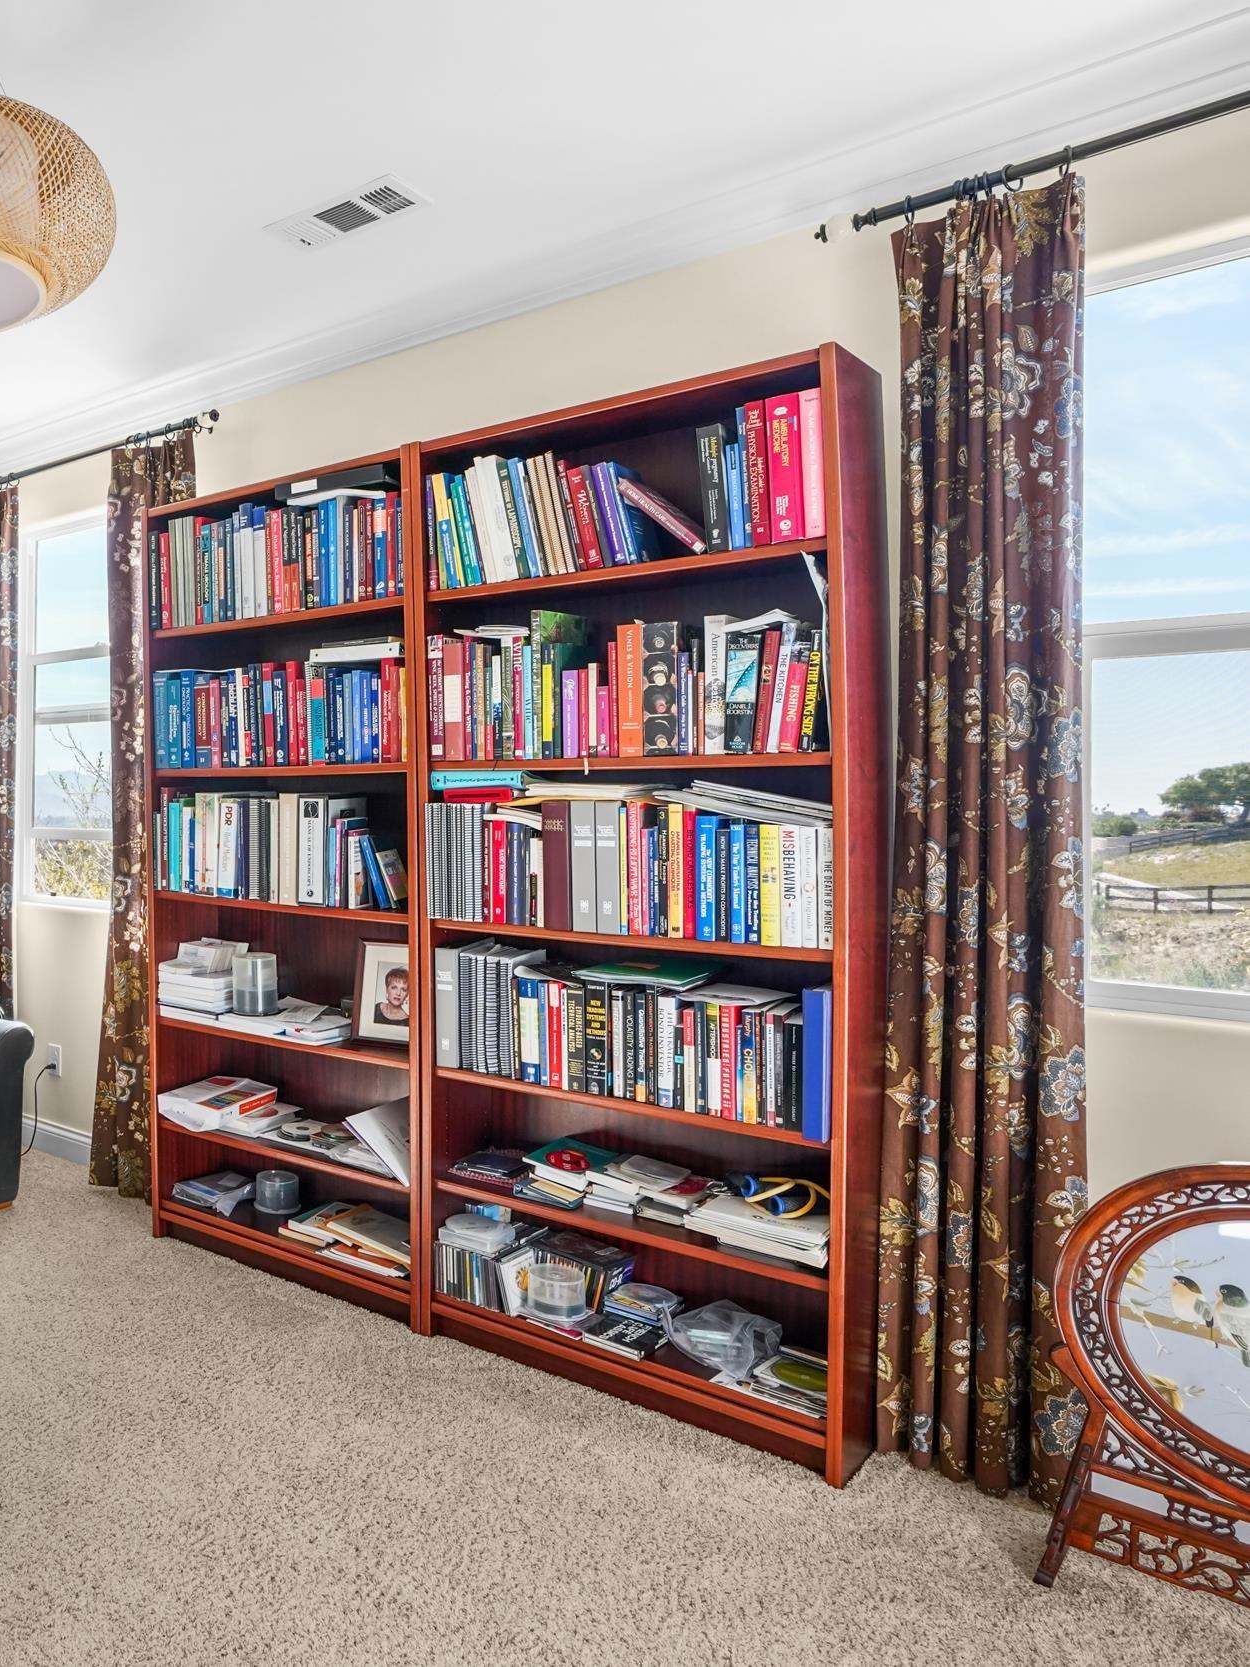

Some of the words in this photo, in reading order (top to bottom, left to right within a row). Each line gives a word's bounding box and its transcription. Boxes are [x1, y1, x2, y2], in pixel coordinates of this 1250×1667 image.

[709, 436, 718, 458] Multiple
[748, 430, 757, 466] PHYSICAL
[772, 419, 781, 454] MEDICINE
[780, 418, 790, 467] AMBULATORY
[749, 467, 761, 523] EXAMINATION
[507, 508, 521, 549] LAPAROSCOPY
[513, 641, 522, 671] wine
[711, 632, 721, 676] American
[780, 653, 788, 668] THE
[810, 651, 821, 664] ON
[775, 670, 786, 704] KITCHEN
[809, 666, 819, 683] THE
[786, 684, 800, 721] FISHING
[804, 683, 818, 715] WRONG
[801, 716, 815, 736] SIDE
[225, 806, 233, 826] PDR
[629, 806, 638, 847] MASTERING
[630, 847, 638, 877] ELLIOTT
[720, 850, 726, 858] TO
[747, 839, 758, 864] TECHNICAL
[747, 865, 758, 890] ANALYSIS
[783, 830, 796, 900] MISBEHAVING
[824, 860, 832, 873] THE
[824, 875, 832, 897] DEATH
[824, 899, 832, 907] OF
[824, 910, 832, 934] MONEY
[590, 999, 601, 1007] NEW
[722, 1013, 730, 1063] INDUSTRIES
[744, 1015, 752, 1037] Murphy
[568, 1028, 576, 1053] ANALYSIS
[722, 1067, 730, 1099] FUTURE
[621, 1324, 653, 1343] FRENCH
